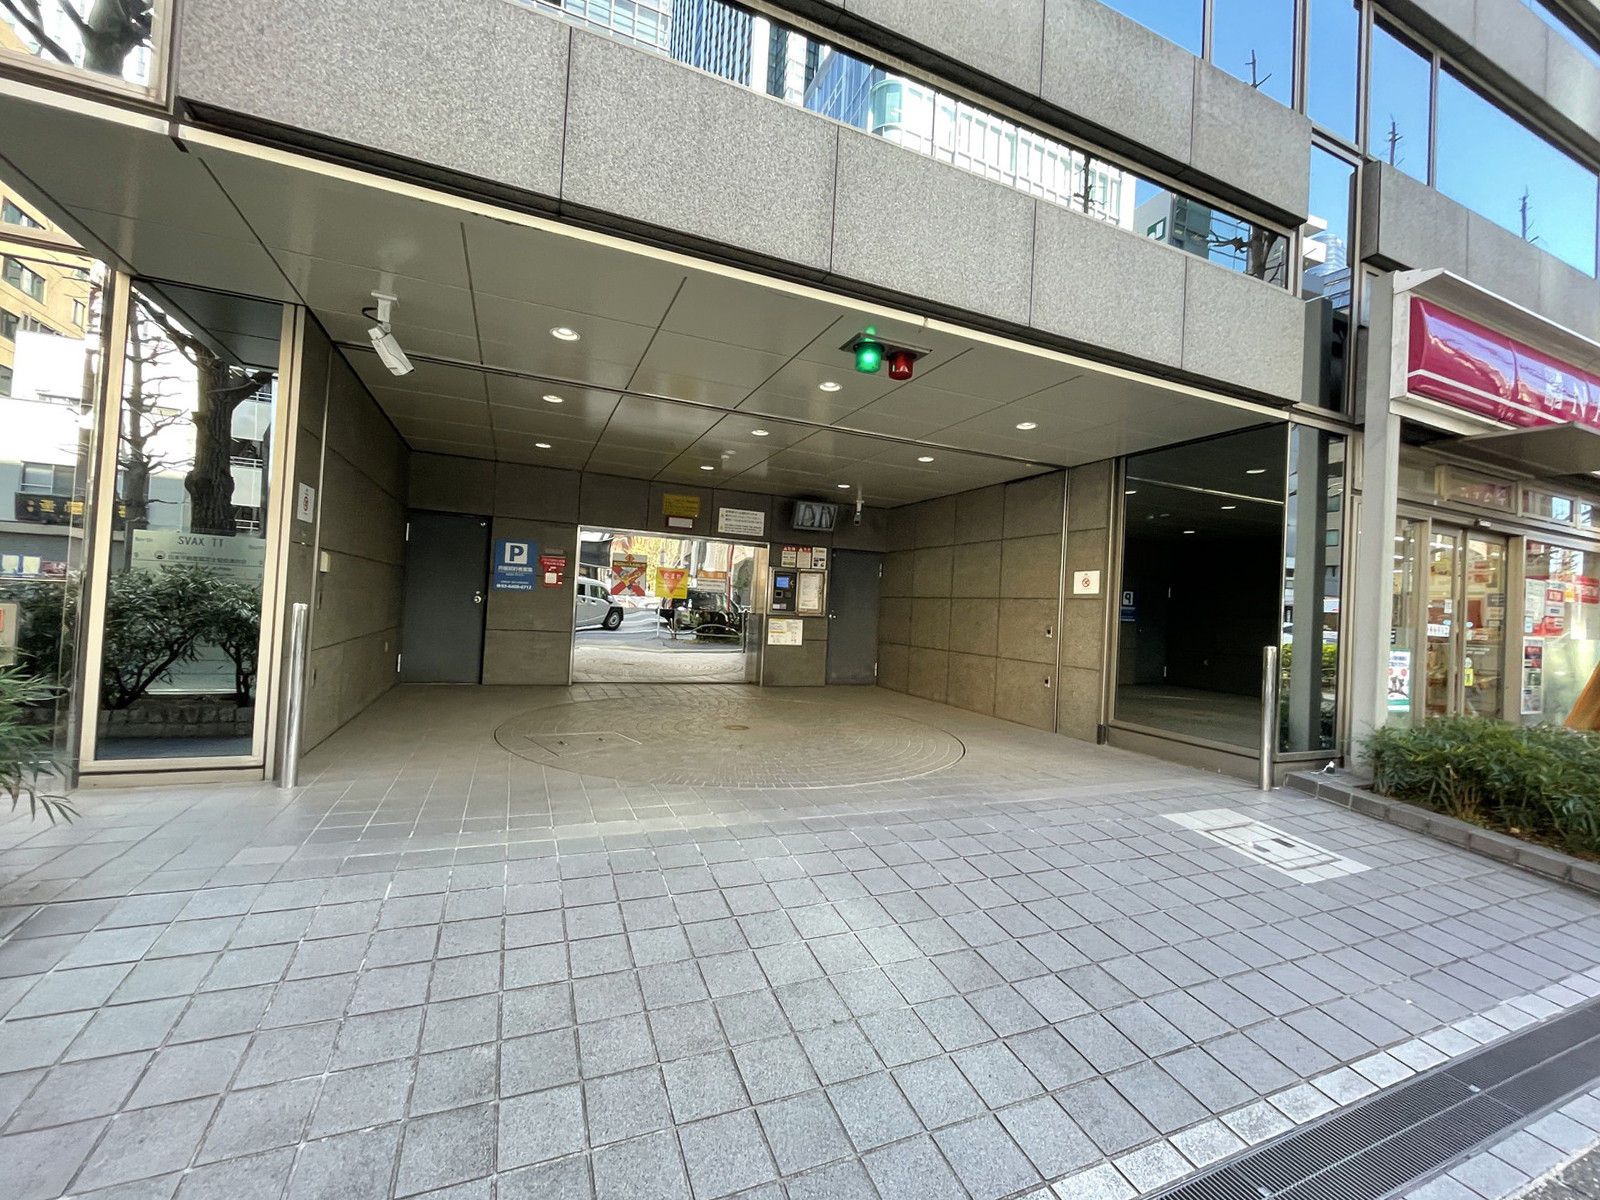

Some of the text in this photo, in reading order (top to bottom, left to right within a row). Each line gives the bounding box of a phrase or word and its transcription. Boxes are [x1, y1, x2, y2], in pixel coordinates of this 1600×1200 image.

[177, 536, 224, 547] SVAX TT
[509, 545, 524, 562] P
